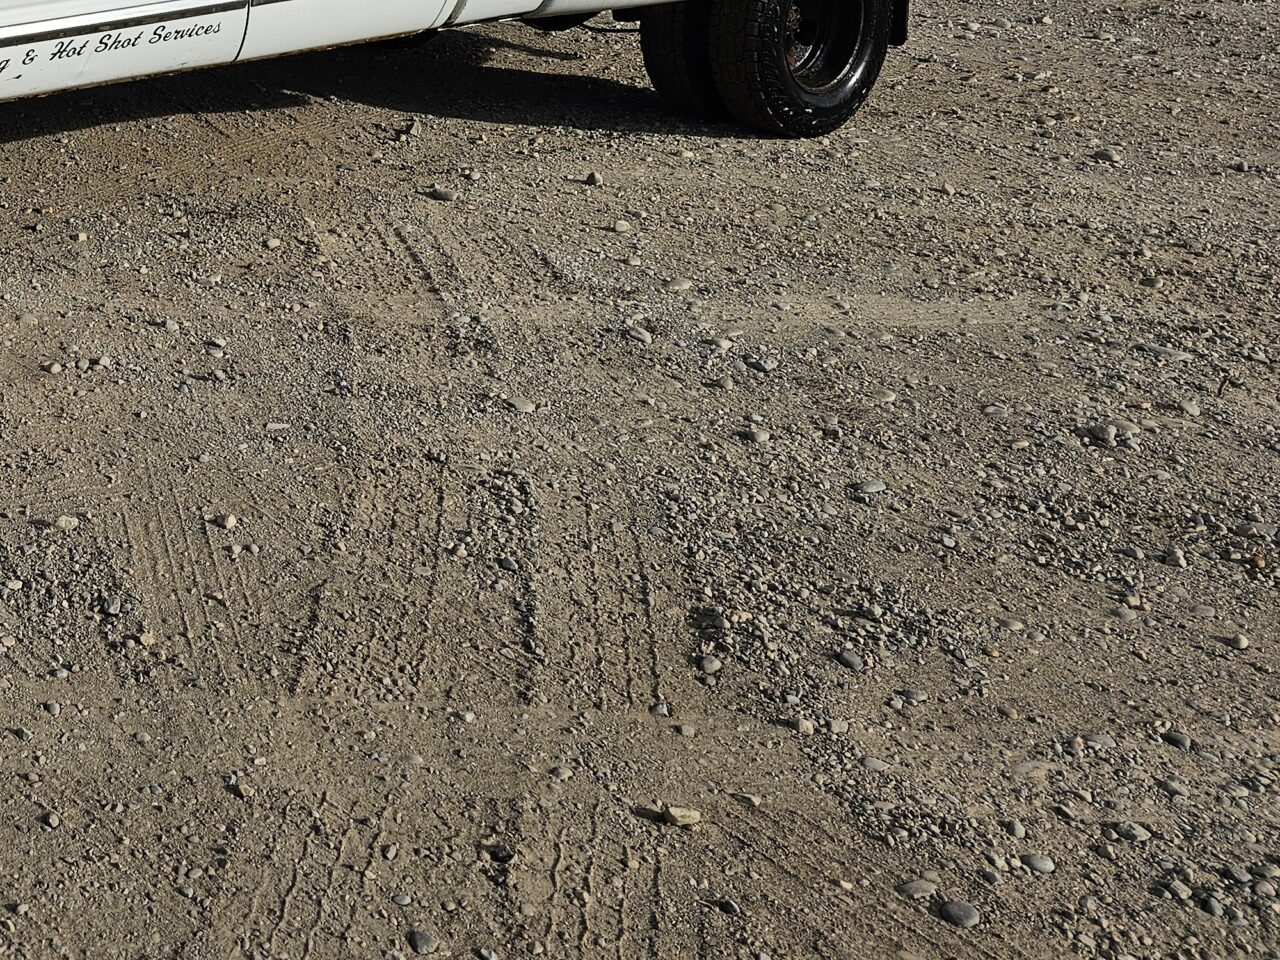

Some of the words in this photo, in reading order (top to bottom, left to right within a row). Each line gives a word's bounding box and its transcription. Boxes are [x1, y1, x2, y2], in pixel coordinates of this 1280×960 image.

[22, 49, 38, 65] &
[49, 39, 87, 61] Hot
[94, 30, 144, 53] Shot
[149, 20, 222, 44] Services
